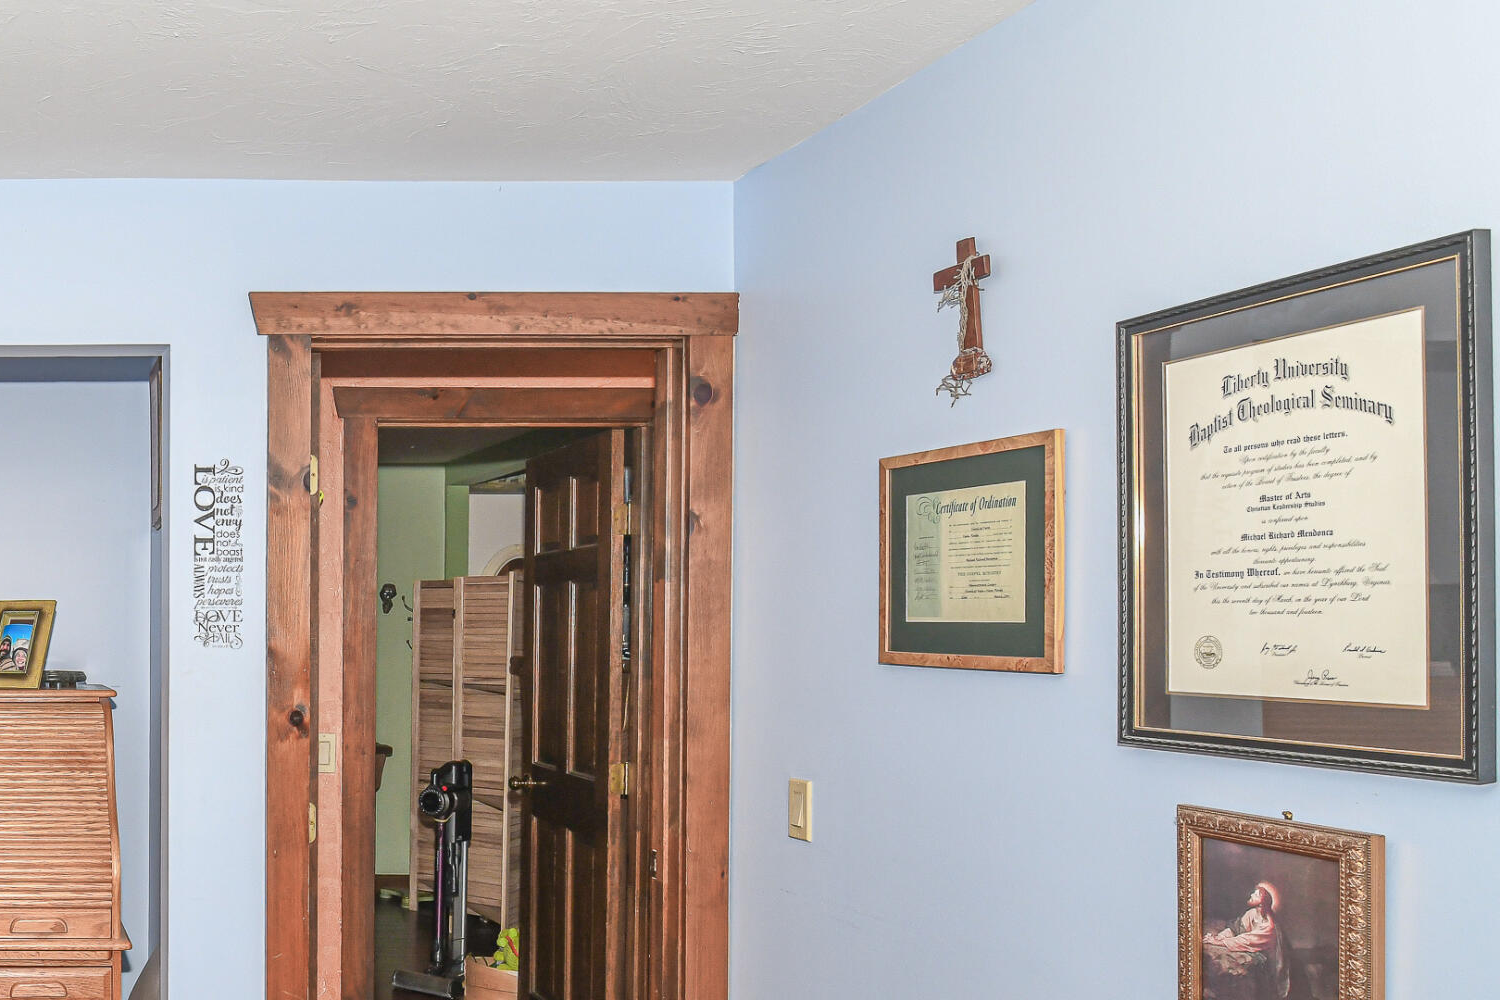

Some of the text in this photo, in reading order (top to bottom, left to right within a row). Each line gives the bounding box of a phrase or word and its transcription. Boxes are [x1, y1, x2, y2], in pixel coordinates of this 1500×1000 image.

[1221, 356, 1351, 398] Liberty University
[1189, 385, 1395, 449] Baptist Theological Seminary
[1234, 444, 1242, 453] all
[1244, 442, 1269, 453] persons
[1270, 438, 1285, 448] who
[1286, 435, 1301, 445] read
[1303, 434, 1321, 444] these
[208, 474, 244, 486] patient
[215, 484, 244, 492] is kind
[215, 491, 243, 504] does
[1260, 491, 1311, 502] Master of Arts
[194, 464, 216, 556] LOVE
[215, 504, 235, 516] not
[936, 494, 1017, 519] Certificate of Ordination
[1272, 502, 1302, 511] Leadership
[215, 518, 243, 531] envy
[216, 530, 241, 538] does
[1240, 529, 1334, 542] Michael Richard Mendonca
[216, 539, 231, 547] not
[216, 548, 244, 556] boast
[205, 564, 244, 576] protects
[1194, 570, 1204, 579] In
[1205, 569, 1245, 579] Testimony
[207, 575, 232, 584] trusts
[207, 584, 234, 598] hopes
[194, 598, 244, 609] perseveres
[195, 610, 243, 622] LOVE
[198, 622, 240, 633] Never
